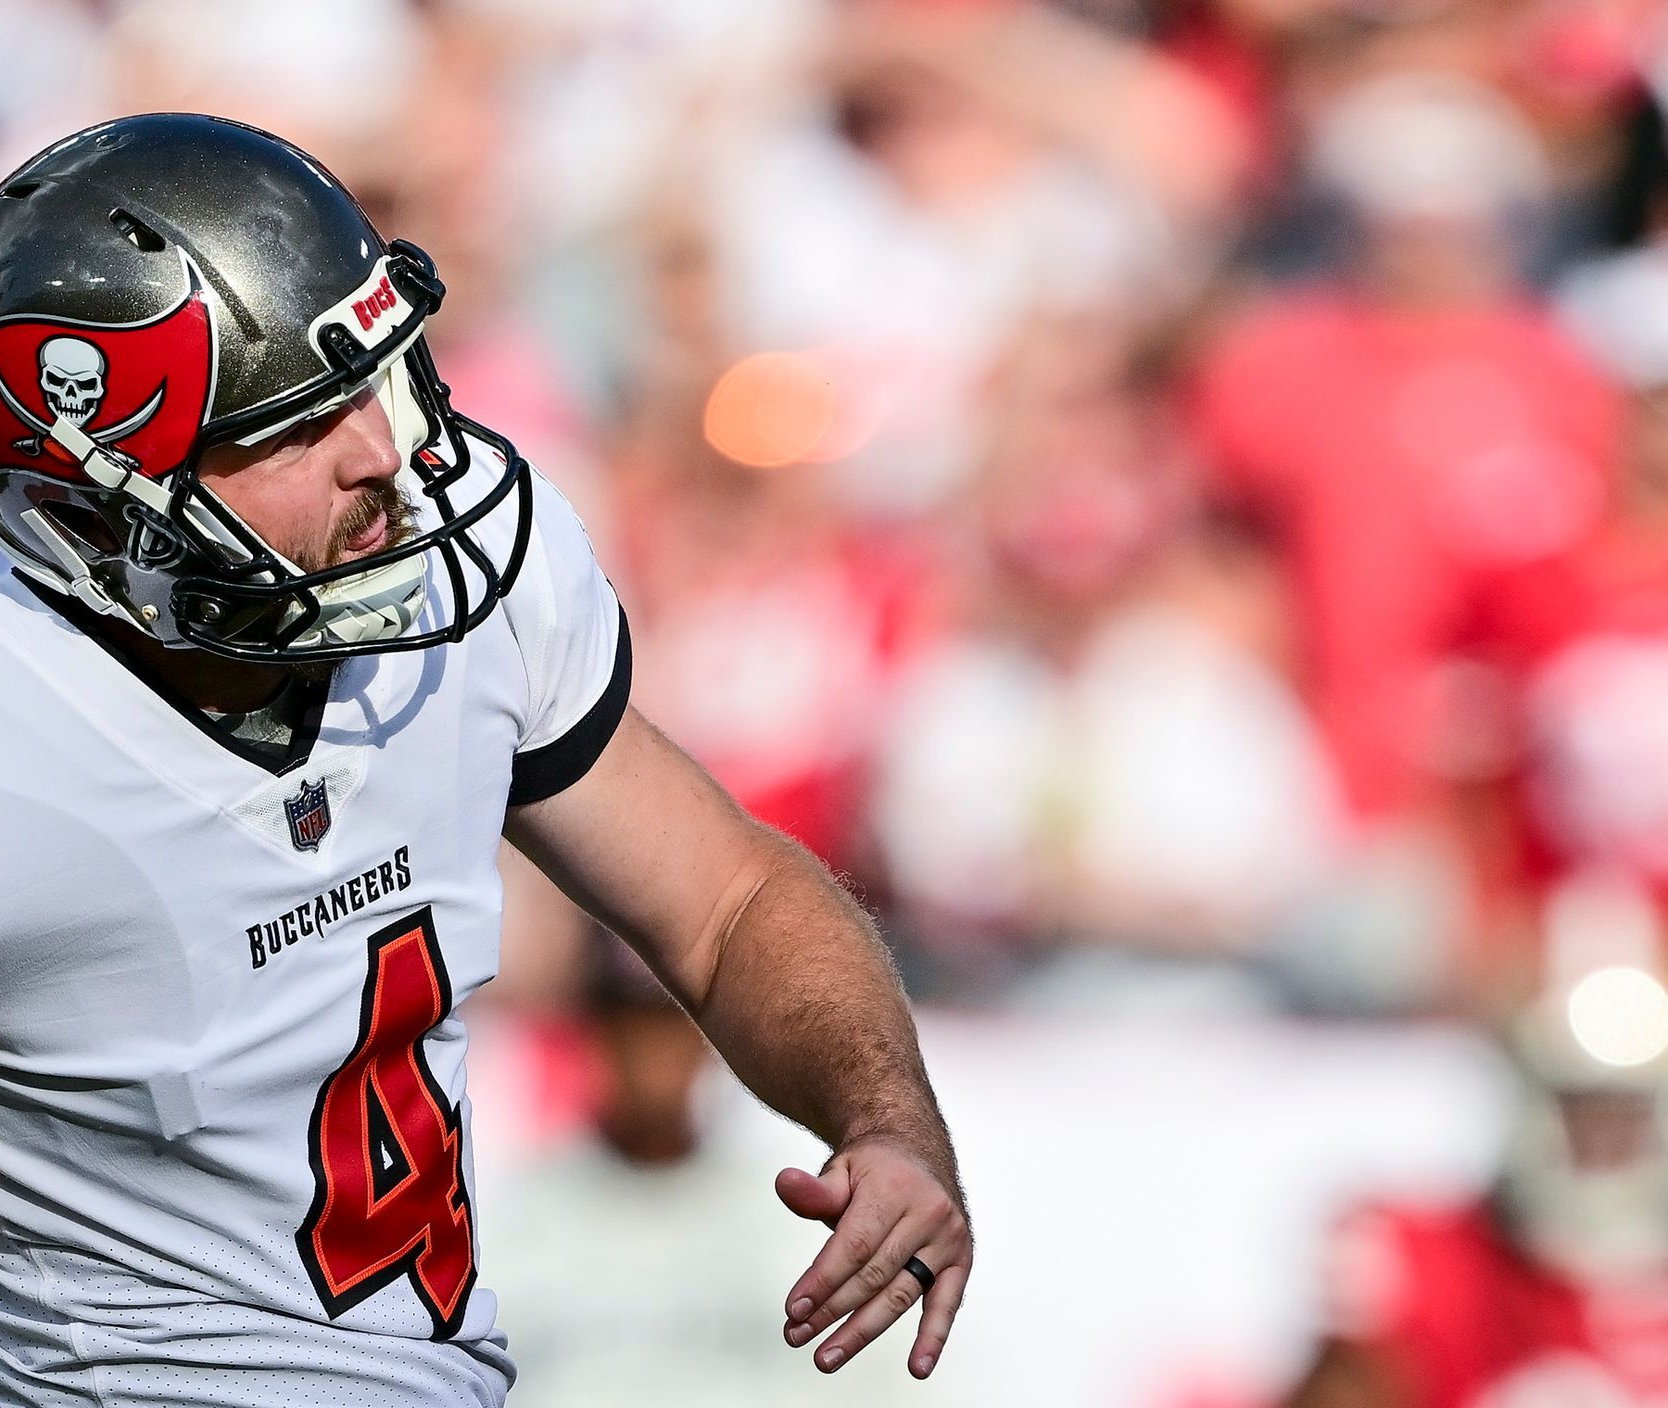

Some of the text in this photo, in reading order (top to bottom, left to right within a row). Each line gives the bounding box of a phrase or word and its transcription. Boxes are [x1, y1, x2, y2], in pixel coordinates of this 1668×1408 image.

[350, 275, 397, 332] BUCS
[297, 807, 326, 842] NFL
[245, 845, 412, 969] BUCCANEERS
[294, 905, 478, 1341] 4
